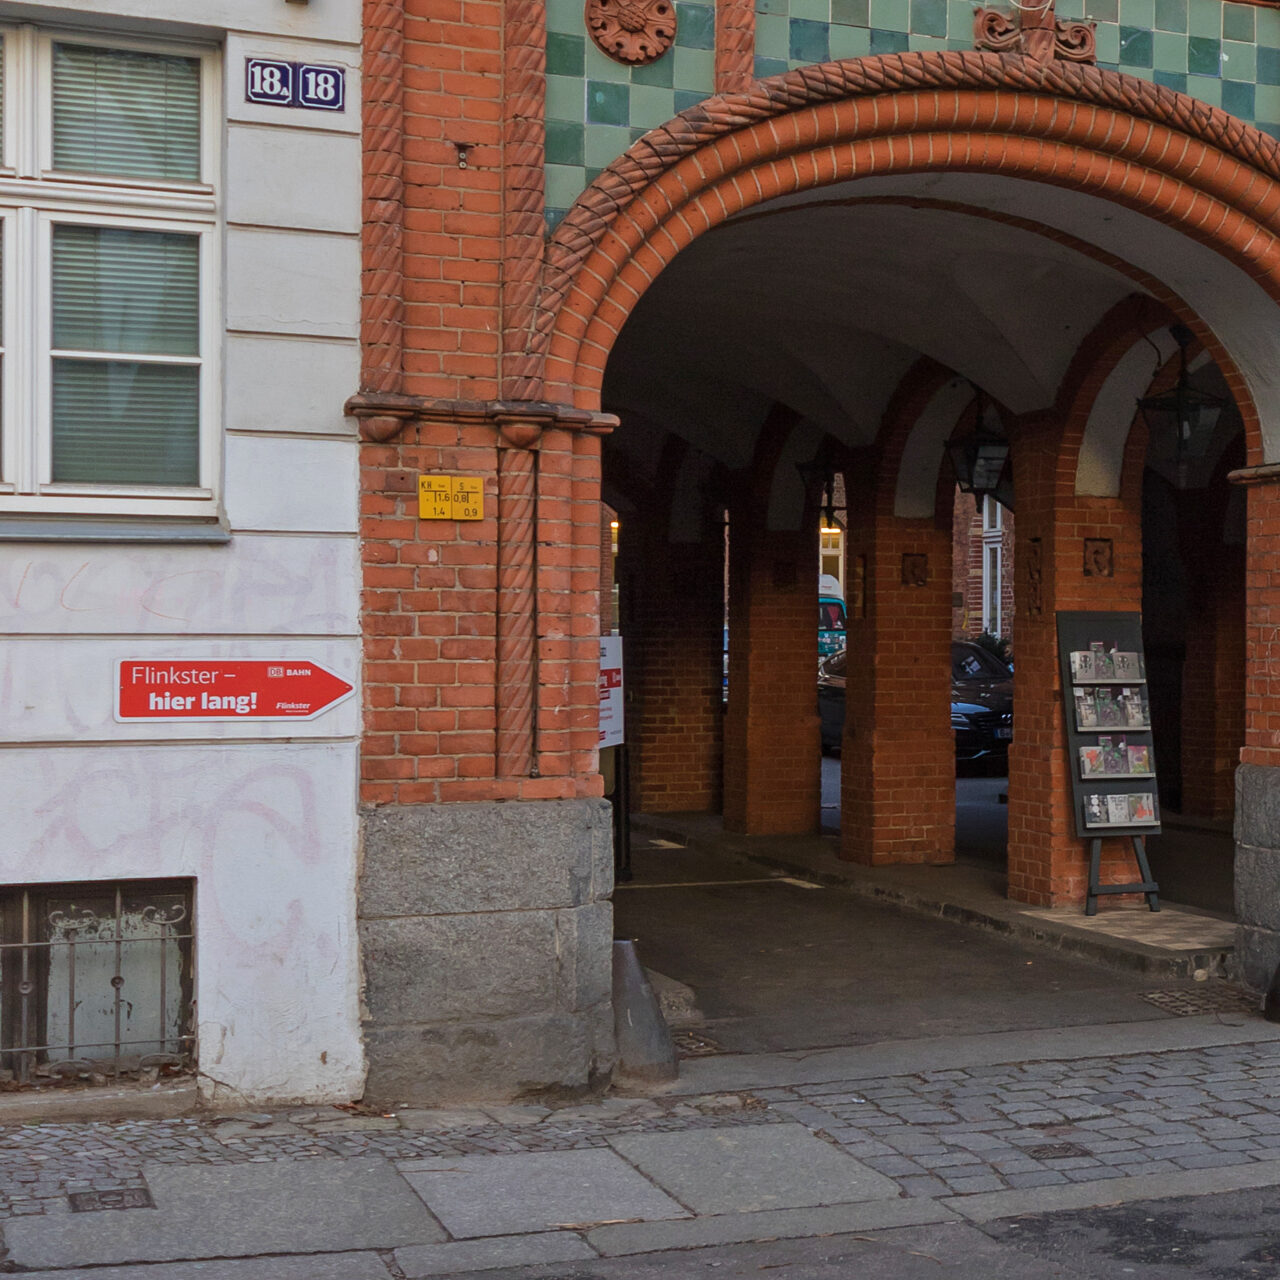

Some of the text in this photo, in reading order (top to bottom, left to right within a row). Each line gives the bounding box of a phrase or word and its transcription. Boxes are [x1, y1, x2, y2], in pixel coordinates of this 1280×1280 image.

[304, 72, 335, 101] 18
[131, 666, 218, 685] Flinkster
[286, 669, 311, 677] BAHN
[149, 692, 257, 714] hier lang!
[275, 702, 311, 710] Flinkster
